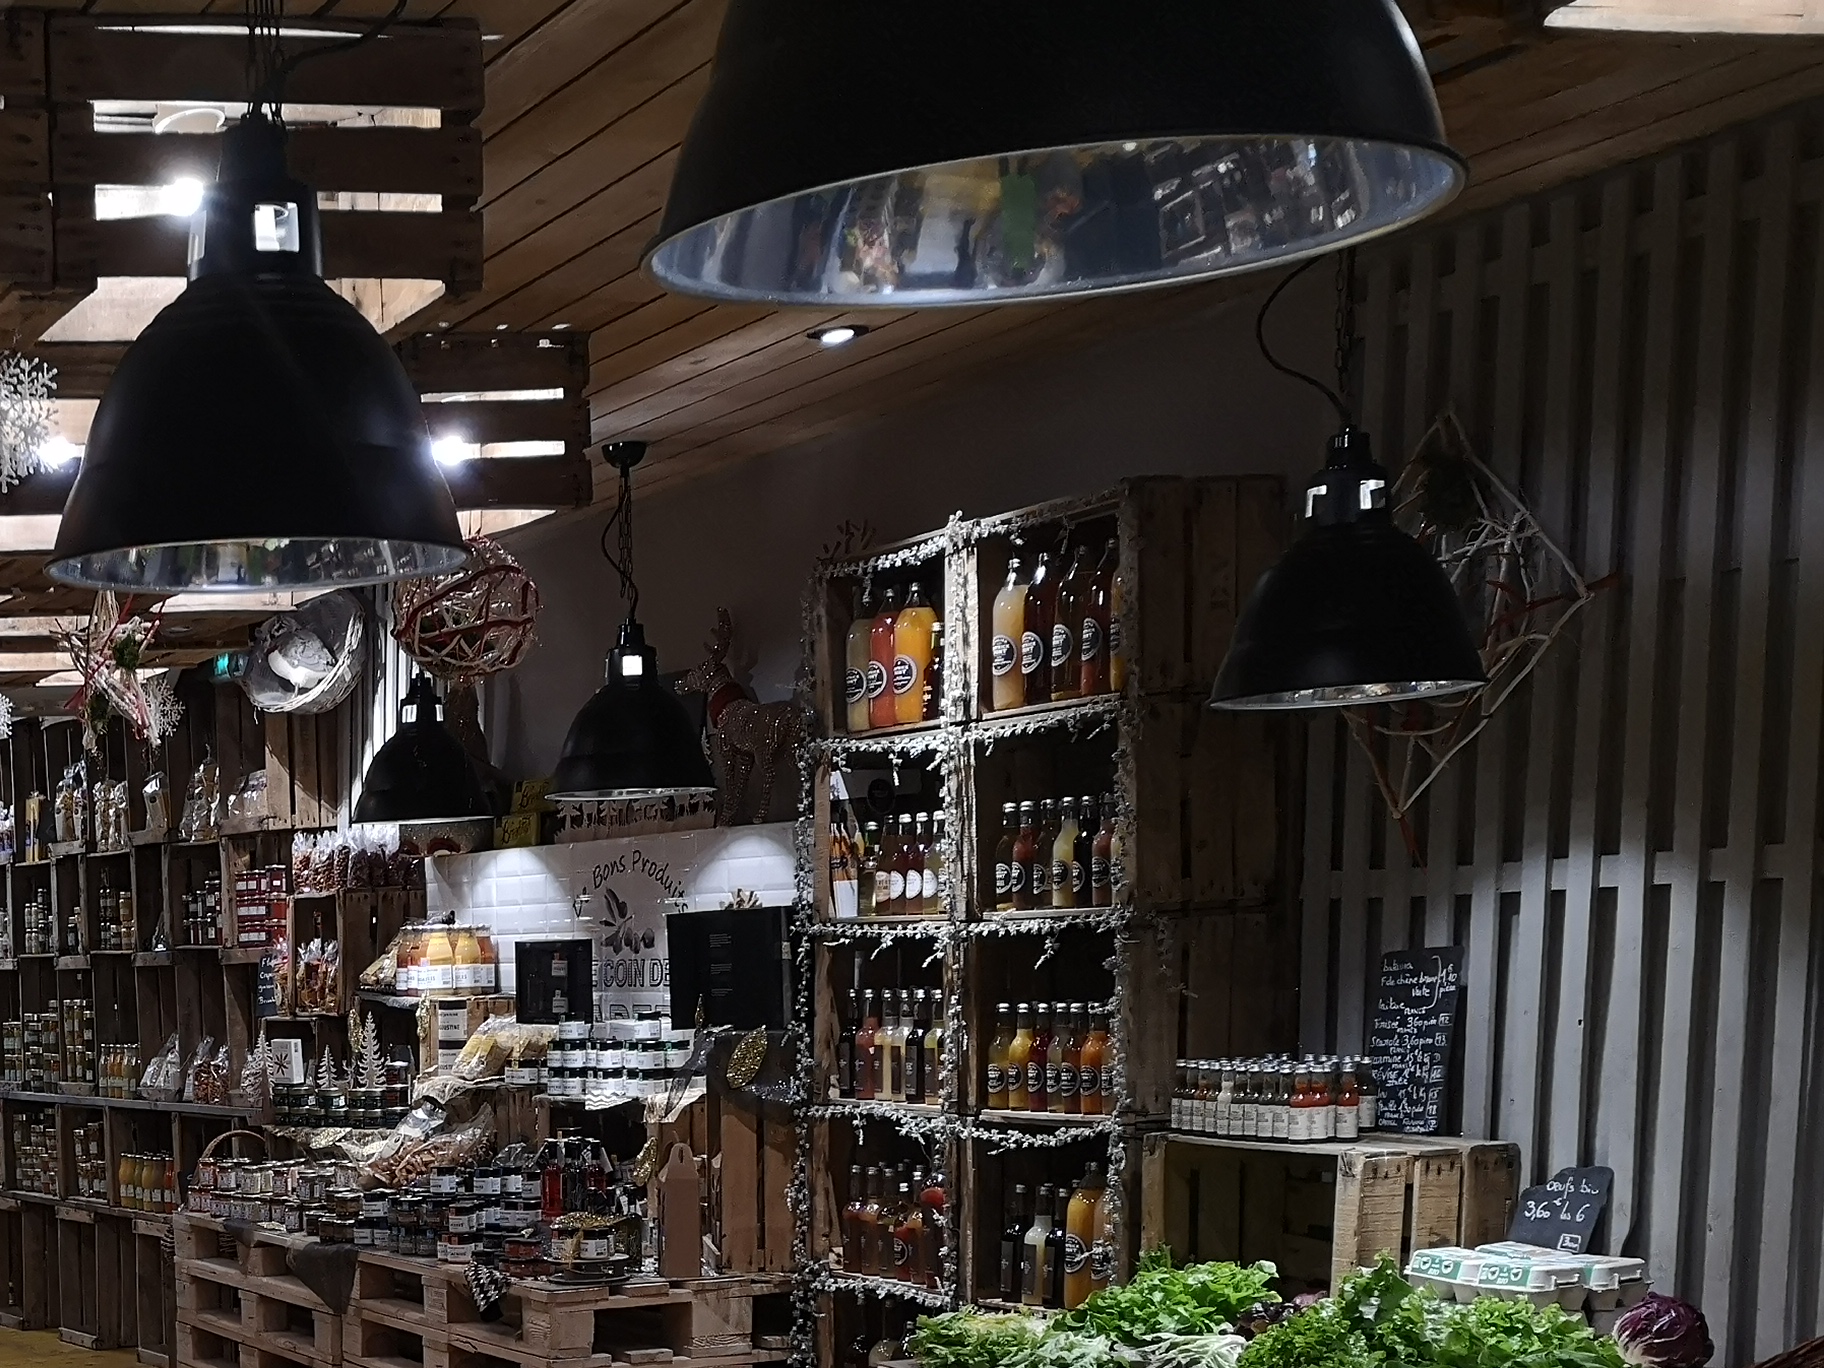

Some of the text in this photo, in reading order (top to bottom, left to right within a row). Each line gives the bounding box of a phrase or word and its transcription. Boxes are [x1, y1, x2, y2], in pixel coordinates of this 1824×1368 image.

[593, 849, 689, 914] Bons Produits
[604, 959, 645, 988] COIN
[1579, 1178, 1600, 1195] bio
[1524, 1200, 1552, 1221] 3,60
[1575, 1203, 1591, 1223] 6
